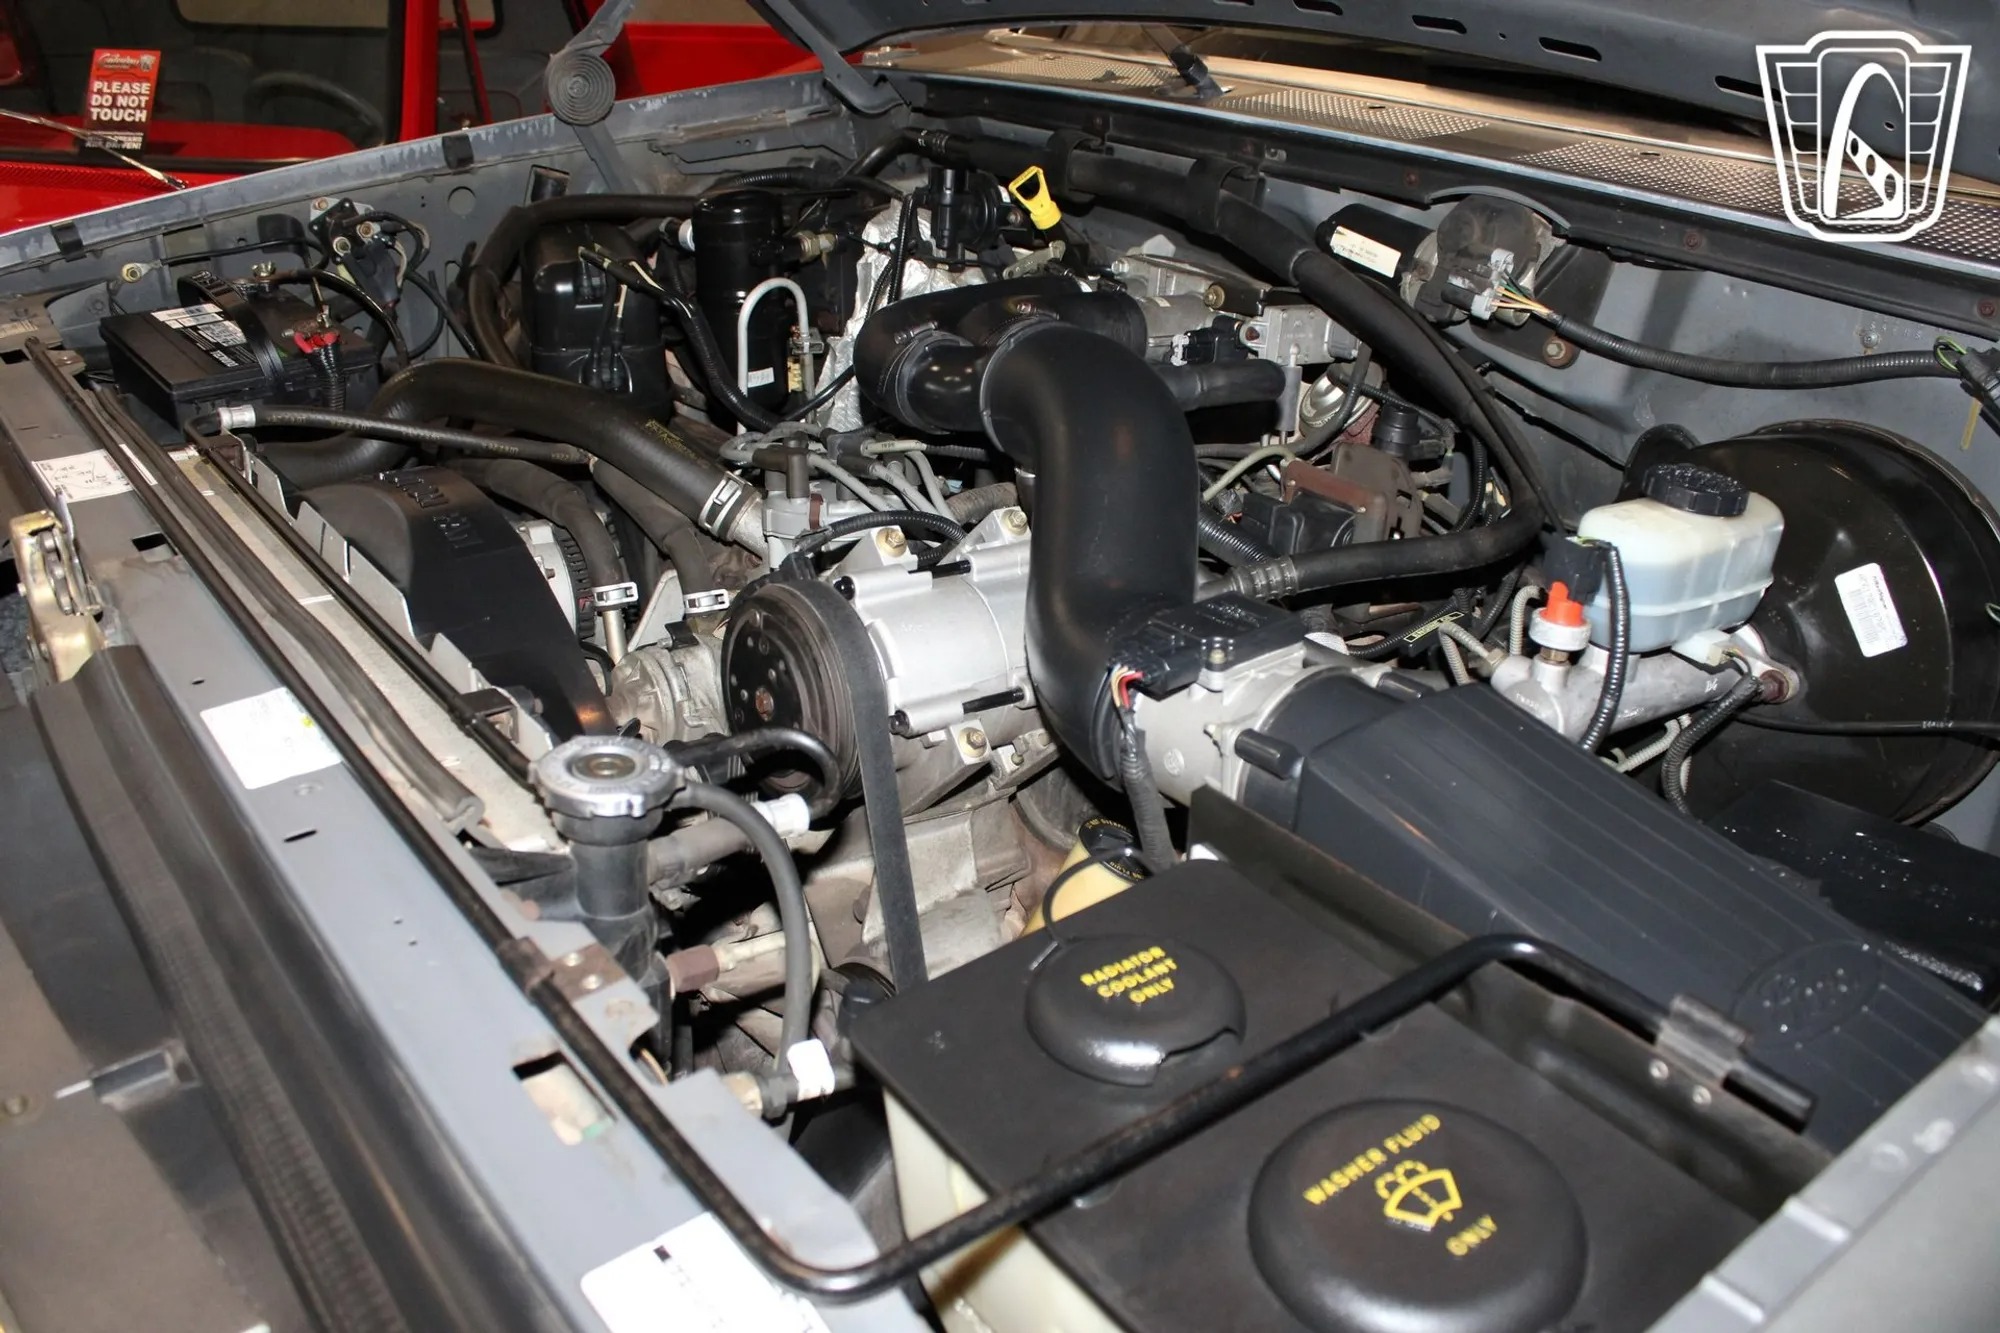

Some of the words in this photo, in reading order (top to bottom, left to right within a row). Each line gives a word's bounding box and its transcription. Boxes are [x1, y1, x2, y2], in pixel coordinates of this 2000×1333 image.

[91, 94, 112, 106] DO
[117, 95, 148, 107] NOT
[93, 81, 150, 93] PLEASE
[90, 108, 147, 122] TOUCH
[1080, 946, 1166, 986] RADIATOR
[1097, 957, 1177, 997] COOLANT
[1129, 977, 1175, 1003] ONLY
[1303, 1148, 1388, 1205] WASHER
[1384, 1114, 1441, 1154] FLUID
[1446, 1214, 1497, 1256] ONLY
